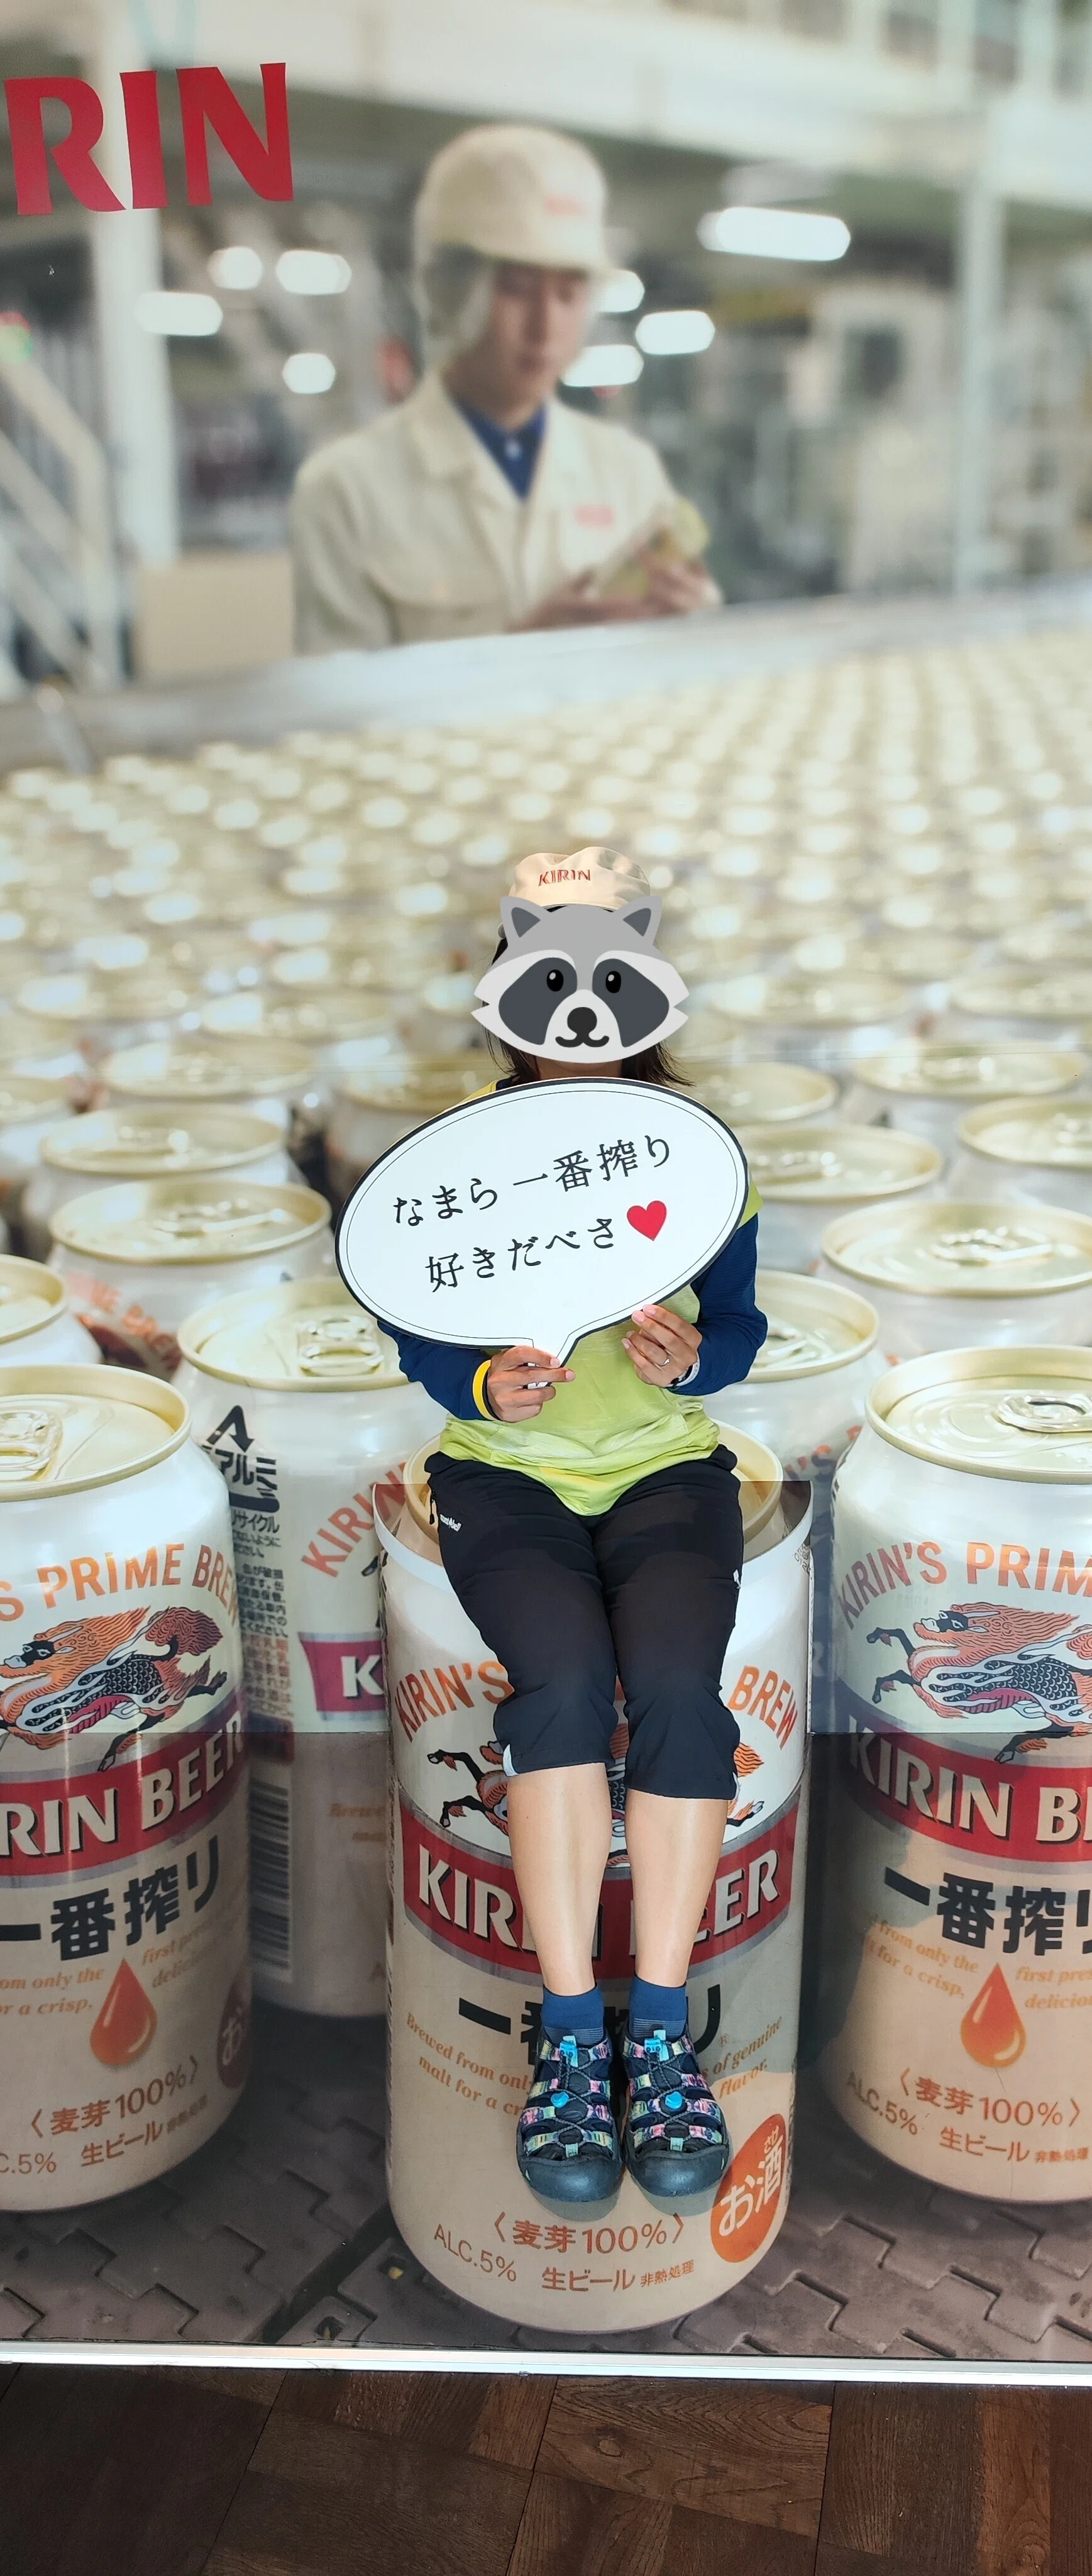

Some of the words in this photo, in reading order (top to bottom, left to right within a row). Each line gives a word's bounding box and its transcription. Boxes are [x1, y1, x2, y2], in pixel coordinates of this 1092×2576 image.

[538, 869, 591, 887] KIRIN
[425, 1218, 614, 1292] 好きだべさ
[215, 1448, 277, 1491] アルミ
[36, 1543, 185, 1609] PRIME
[838, 1541, 947, 1630] KIRIN'S
[395, 1660, 516, 1743] KIRIN'S
[727, 1665, 798, 1751] BREW
[141, 1711, 245, 1833] BEER
[849, 1714, 1015, 1841] KIRIN
[77, 1967, 104, 1984] the
[407, 2011, 454, 2060] Brewed
[456, 2051, 495, 2081] from
[499, 2073, 533, 2096] onl
[731, 2016, 783, 2070] genuine
[419, 2056, 452, 2087] malt
[455, 2079, 482, 2101] for
[485, 2096, 499, 2109] a
[846, 2071, 918, 2136] ALC.5%
[81, 2120, 163, 2167] 生ビール
[939, 2126, 1030, 2162] 生ビール
[719, 2135, 784, 2238] お酒
[434, 2223, 517, 2282] ALC.5%
[541, 2267, 636, 2292] 生ビール
